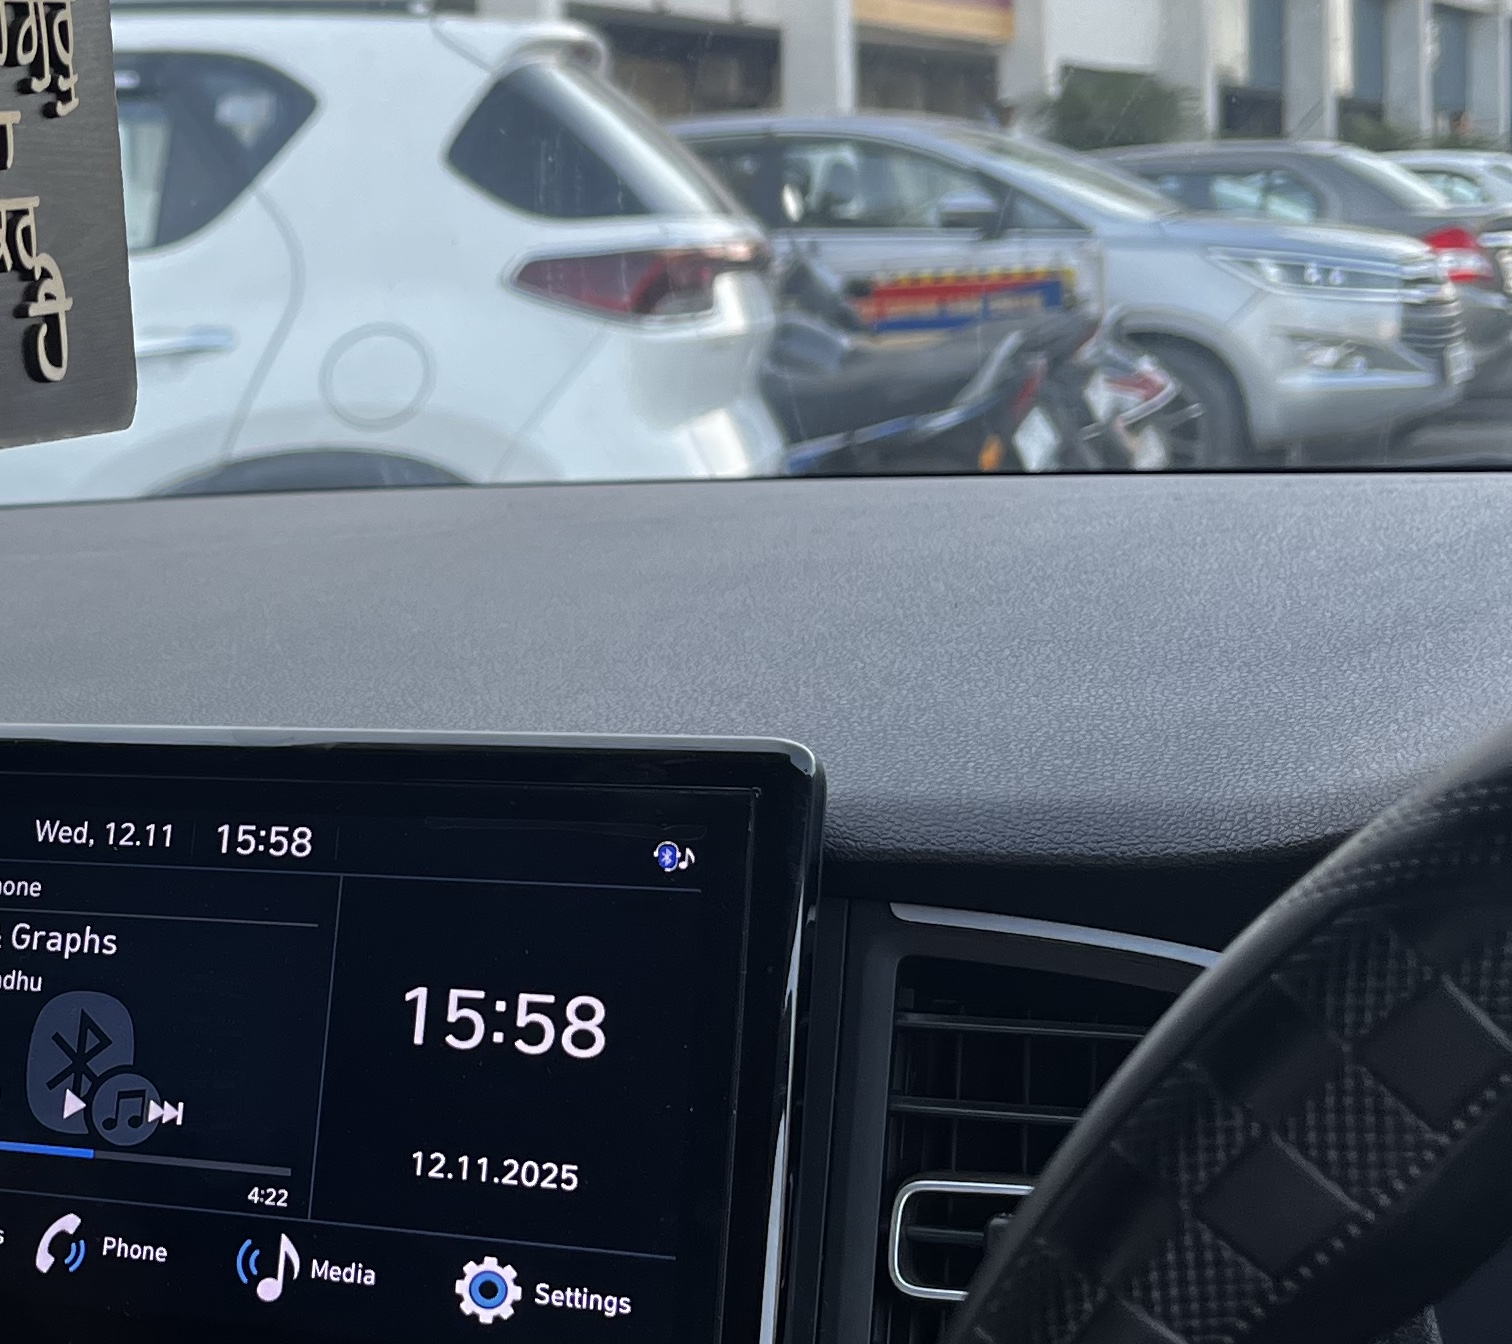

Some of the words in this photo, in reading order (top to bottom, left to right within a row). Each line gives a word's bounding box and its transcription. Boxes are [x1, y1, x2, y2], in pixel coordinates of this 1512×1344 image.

[26, 252, 74, 382] ਹੈ
[35, 818, 97, 848] Wed,
[104, 822, 174, 849] 12.11
[217, 823, 313, 858] 15:58
[11, 922, 118, 959] Graphs
[404, 986, 607, 1058] 15:58
[411, 1150, 579, 1192] 12.11.2025
[247, 1186, 289, 1208] 4:22
[102, 1235, 168, 1263] Phone
[311, 1258, 377, 1286] Media
[534, 1283, 632, 1317] Settings
